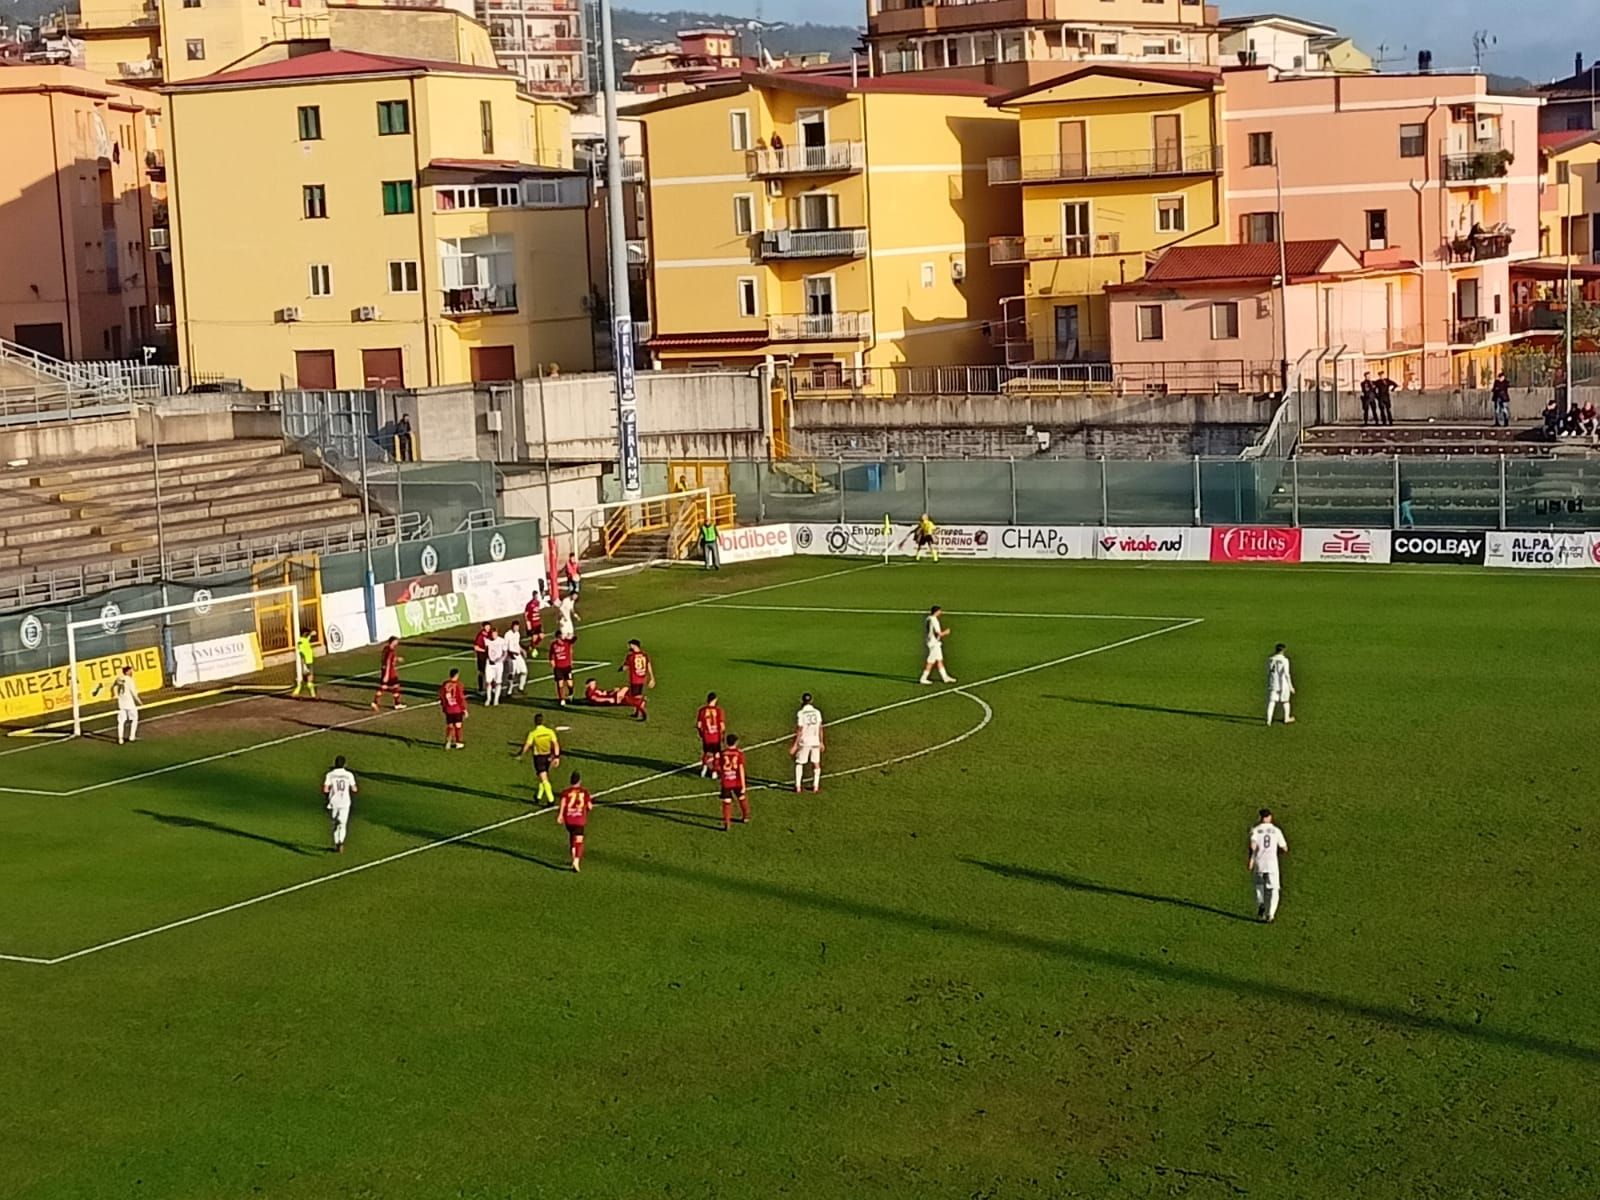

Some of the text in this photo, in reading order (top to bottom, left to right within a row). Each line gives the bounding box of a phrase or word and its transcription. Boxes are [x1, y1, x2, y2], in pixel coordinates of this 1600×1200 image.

[627, 424, 637, 479] FRIMM
[721, 529, 788, 551] bidibee
[1238, 530, 1286, 551] Fides
[1395, 538, 1482, 557] COOLBAY
[1511, 551, 1554, 563] IVECO
[424, 593, 458, 618] FAP
[336, 779, 345, 791] 10
[1263, 834, 1271, 849] 8
